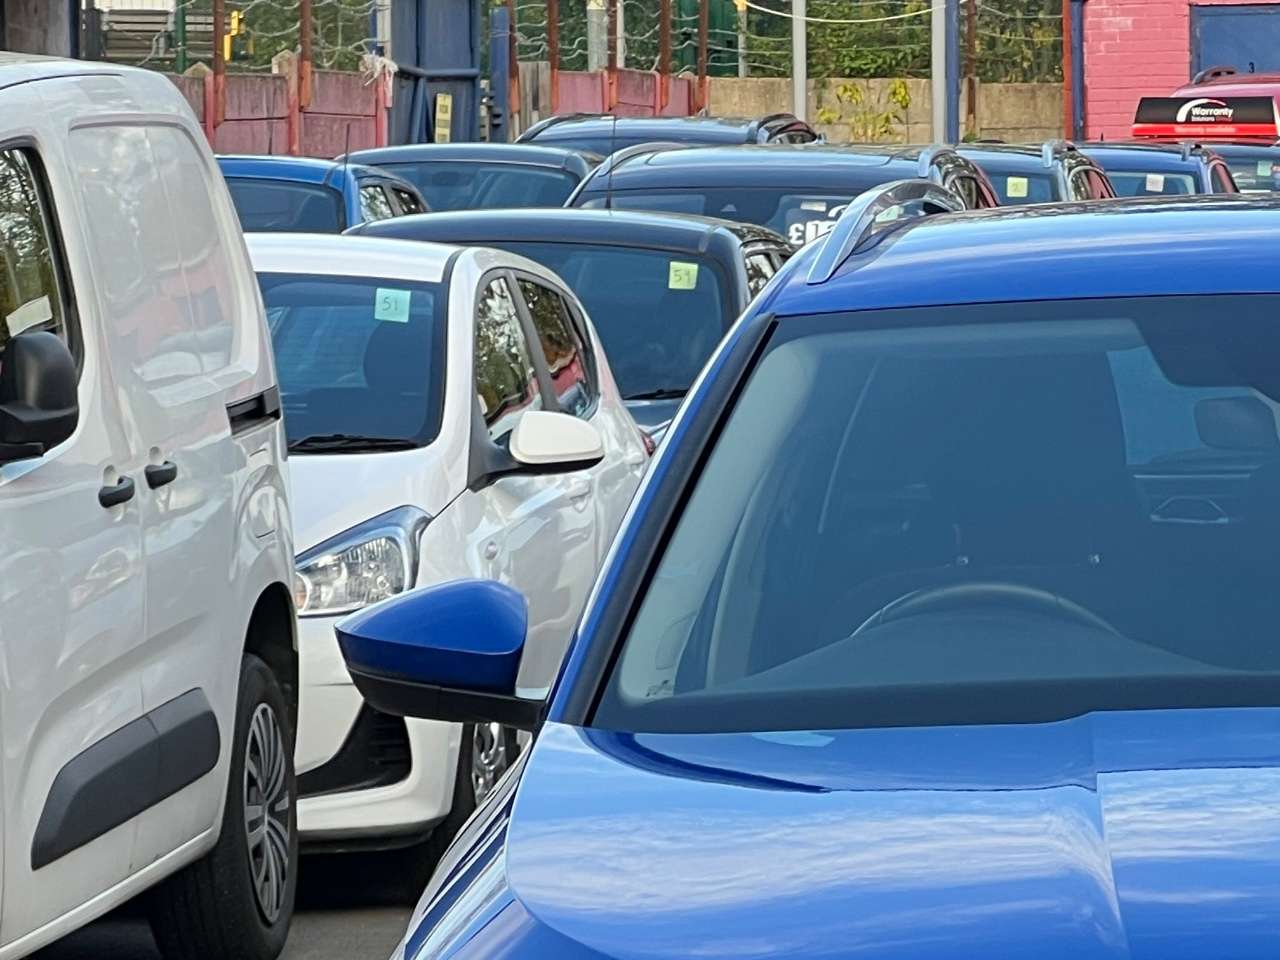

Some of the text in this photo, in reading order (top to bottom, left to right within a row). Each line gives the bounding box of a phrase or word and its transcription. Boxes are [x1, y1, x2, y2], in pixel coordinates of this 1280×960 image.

[1248, 61, 1255, 74] 3
[1191, 107, 1233, 117] Warranty
[382, 296, 399, 311] 51
